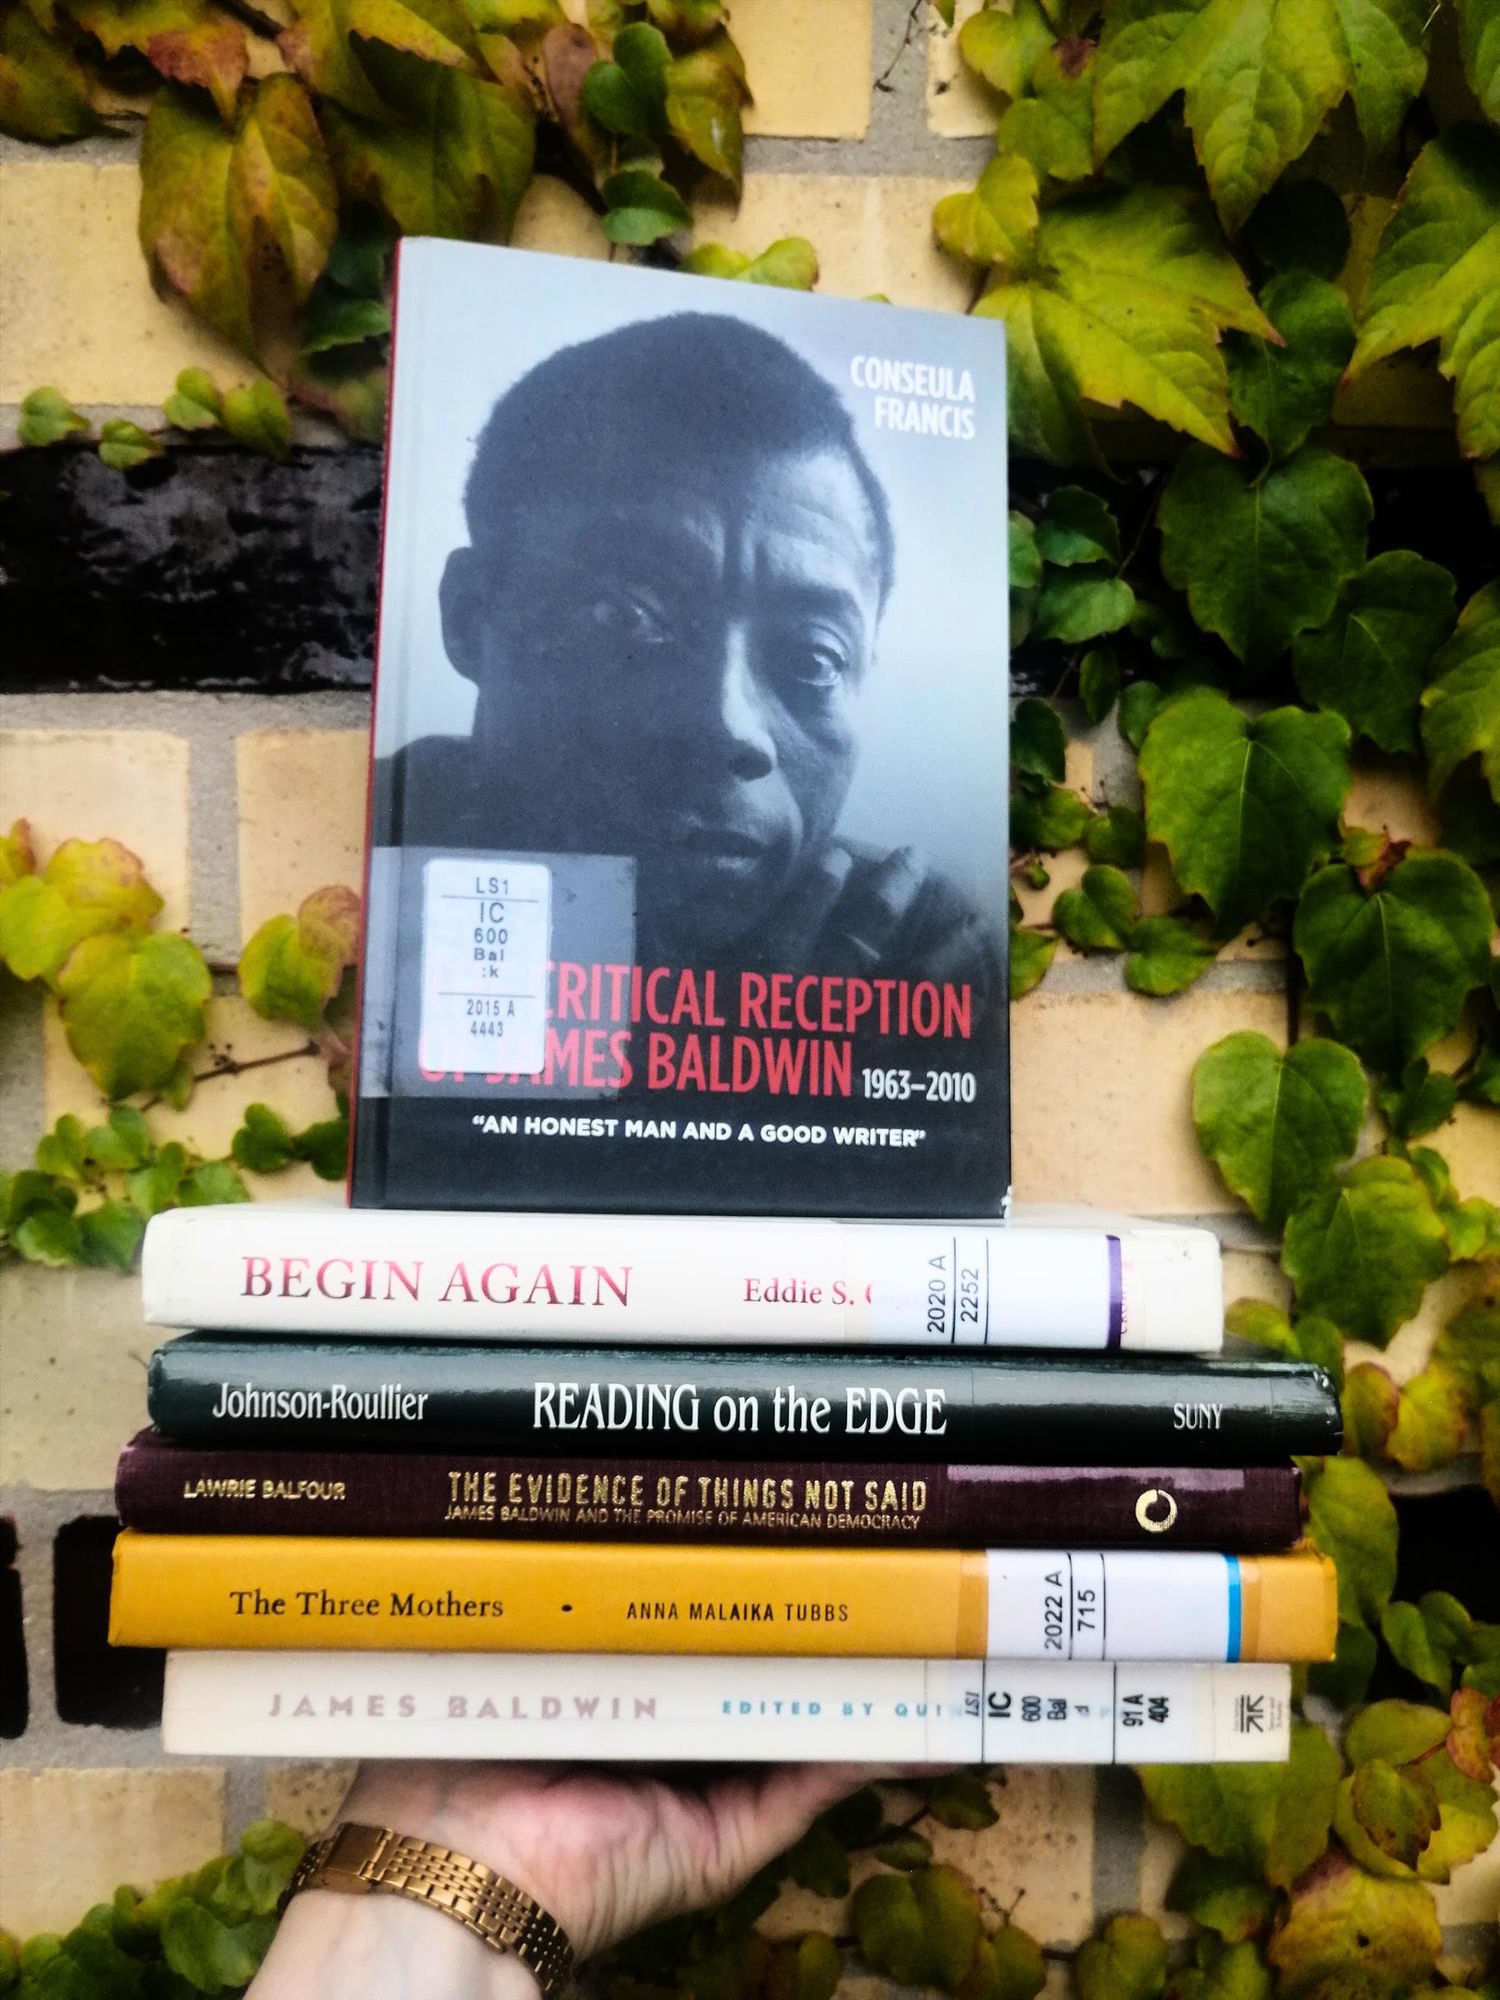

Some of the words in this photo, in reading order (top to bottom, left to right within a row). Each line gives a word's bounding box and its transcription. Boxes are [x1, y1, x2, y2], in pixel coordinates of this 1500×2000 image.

[850, 355, 975, 403] CONSEULA
[875, 396, 975, 440] FRANCIS
[476, 877, 509, 895] LS1
[480, 902, 504, 924] IC
[474, 928, 508, 945] 600
[474, 947, 504, 961] Bal
[467, 999, 500, 1017] 2015
[506, 1001, 515, 1017] A
[740, 971, 972, 1040] RECEPTION
[470, 1022, 504, 1038] 4443
[647, 1033, 853, 1098] BALDWIN
[524, 1116, 618, 1139] HONEST
[624, 1120, 677, 1139] MAN
[682, 1122, 732, 1141] AND
[737, 1123, 755, 1142] A
[760, 1125, 827, 1144] GOOD
[928, 1255, 946, 1271] A
[240, 1256, 424, 1301] BEGIN
[438, 1261, 633, 1307] AGAIN
[743, 1277, 822, 1304] Eddie
[831, 1280, 855, 1306] S.
[927, 1279, 946, 1333] 2020
[960, 1268, 979, 1323] 2252
[212, 1382, 429, 1422] Johnson-Roullier
[533, 1381, 700, 1432] READING
[713, 1396, 760, 1434] on
[773, 1385, 831, 1433] the
[844, 1386, 947, 1436] EDGE
[1173, 1403, 1223, 1431] SUNY
[183, 1479, 256, 1499] LAWRIE
[261, 1480, 347, 1501] BALFOUR
[448, 1471, 497, 1503] THE
[508, 1472, 644, 1507] EVIDENCE
[656, 1475, 690, 1508] OF
[697, 1476, 795, 1510] THINGS
[804, 1479, 855, 1511] NOT
[864, 1479, 927, 1511] SAID
[444, 1504, 495, 1521] JAMES
[500, 1506, 571, 1523] BALDWIN
[575, 1507, 609, 1524] AND
[614, 1507, 642, 1524] THE
[646, 1508, 713, 1526] PROMISE
[717, 1511, 739, 1526] OF
[742, 1511, 822, 1529] AMERICAN
[826, 1512, 921, 1530] DEMOCRACY
[1046, 1570, 1063, 1587] A
[230, 1590, 286, 1616] The
[295, 1590, 380, 1616] Three
[390, 1591, 505, 1617] Mothers
[626, 1601, 679, 1621] ANNA
[689, 1602, 775, 1622] MALAIKA
[784, 1603, 849, 1622] TUBBS
[1077, 1589, 1096, 1632] 715
[1044, 1595, 1064, 1650] 2022
[268, 1694, 416, 1718] JAMES
[447, 1696, 657, 1719] BALDWIN
[722, 1701, 821, 1715] EDITED
[843, 1703, 873, 1716] BY
[988, 1691, 1011, 1718] IC
[1021, 1695, 1041, 1722] 600
[1123, 1693, 1143, 1705] A
[1147, 1696, 1169, 1723] 404
[1122, 1711, 1144, 1727] 91
